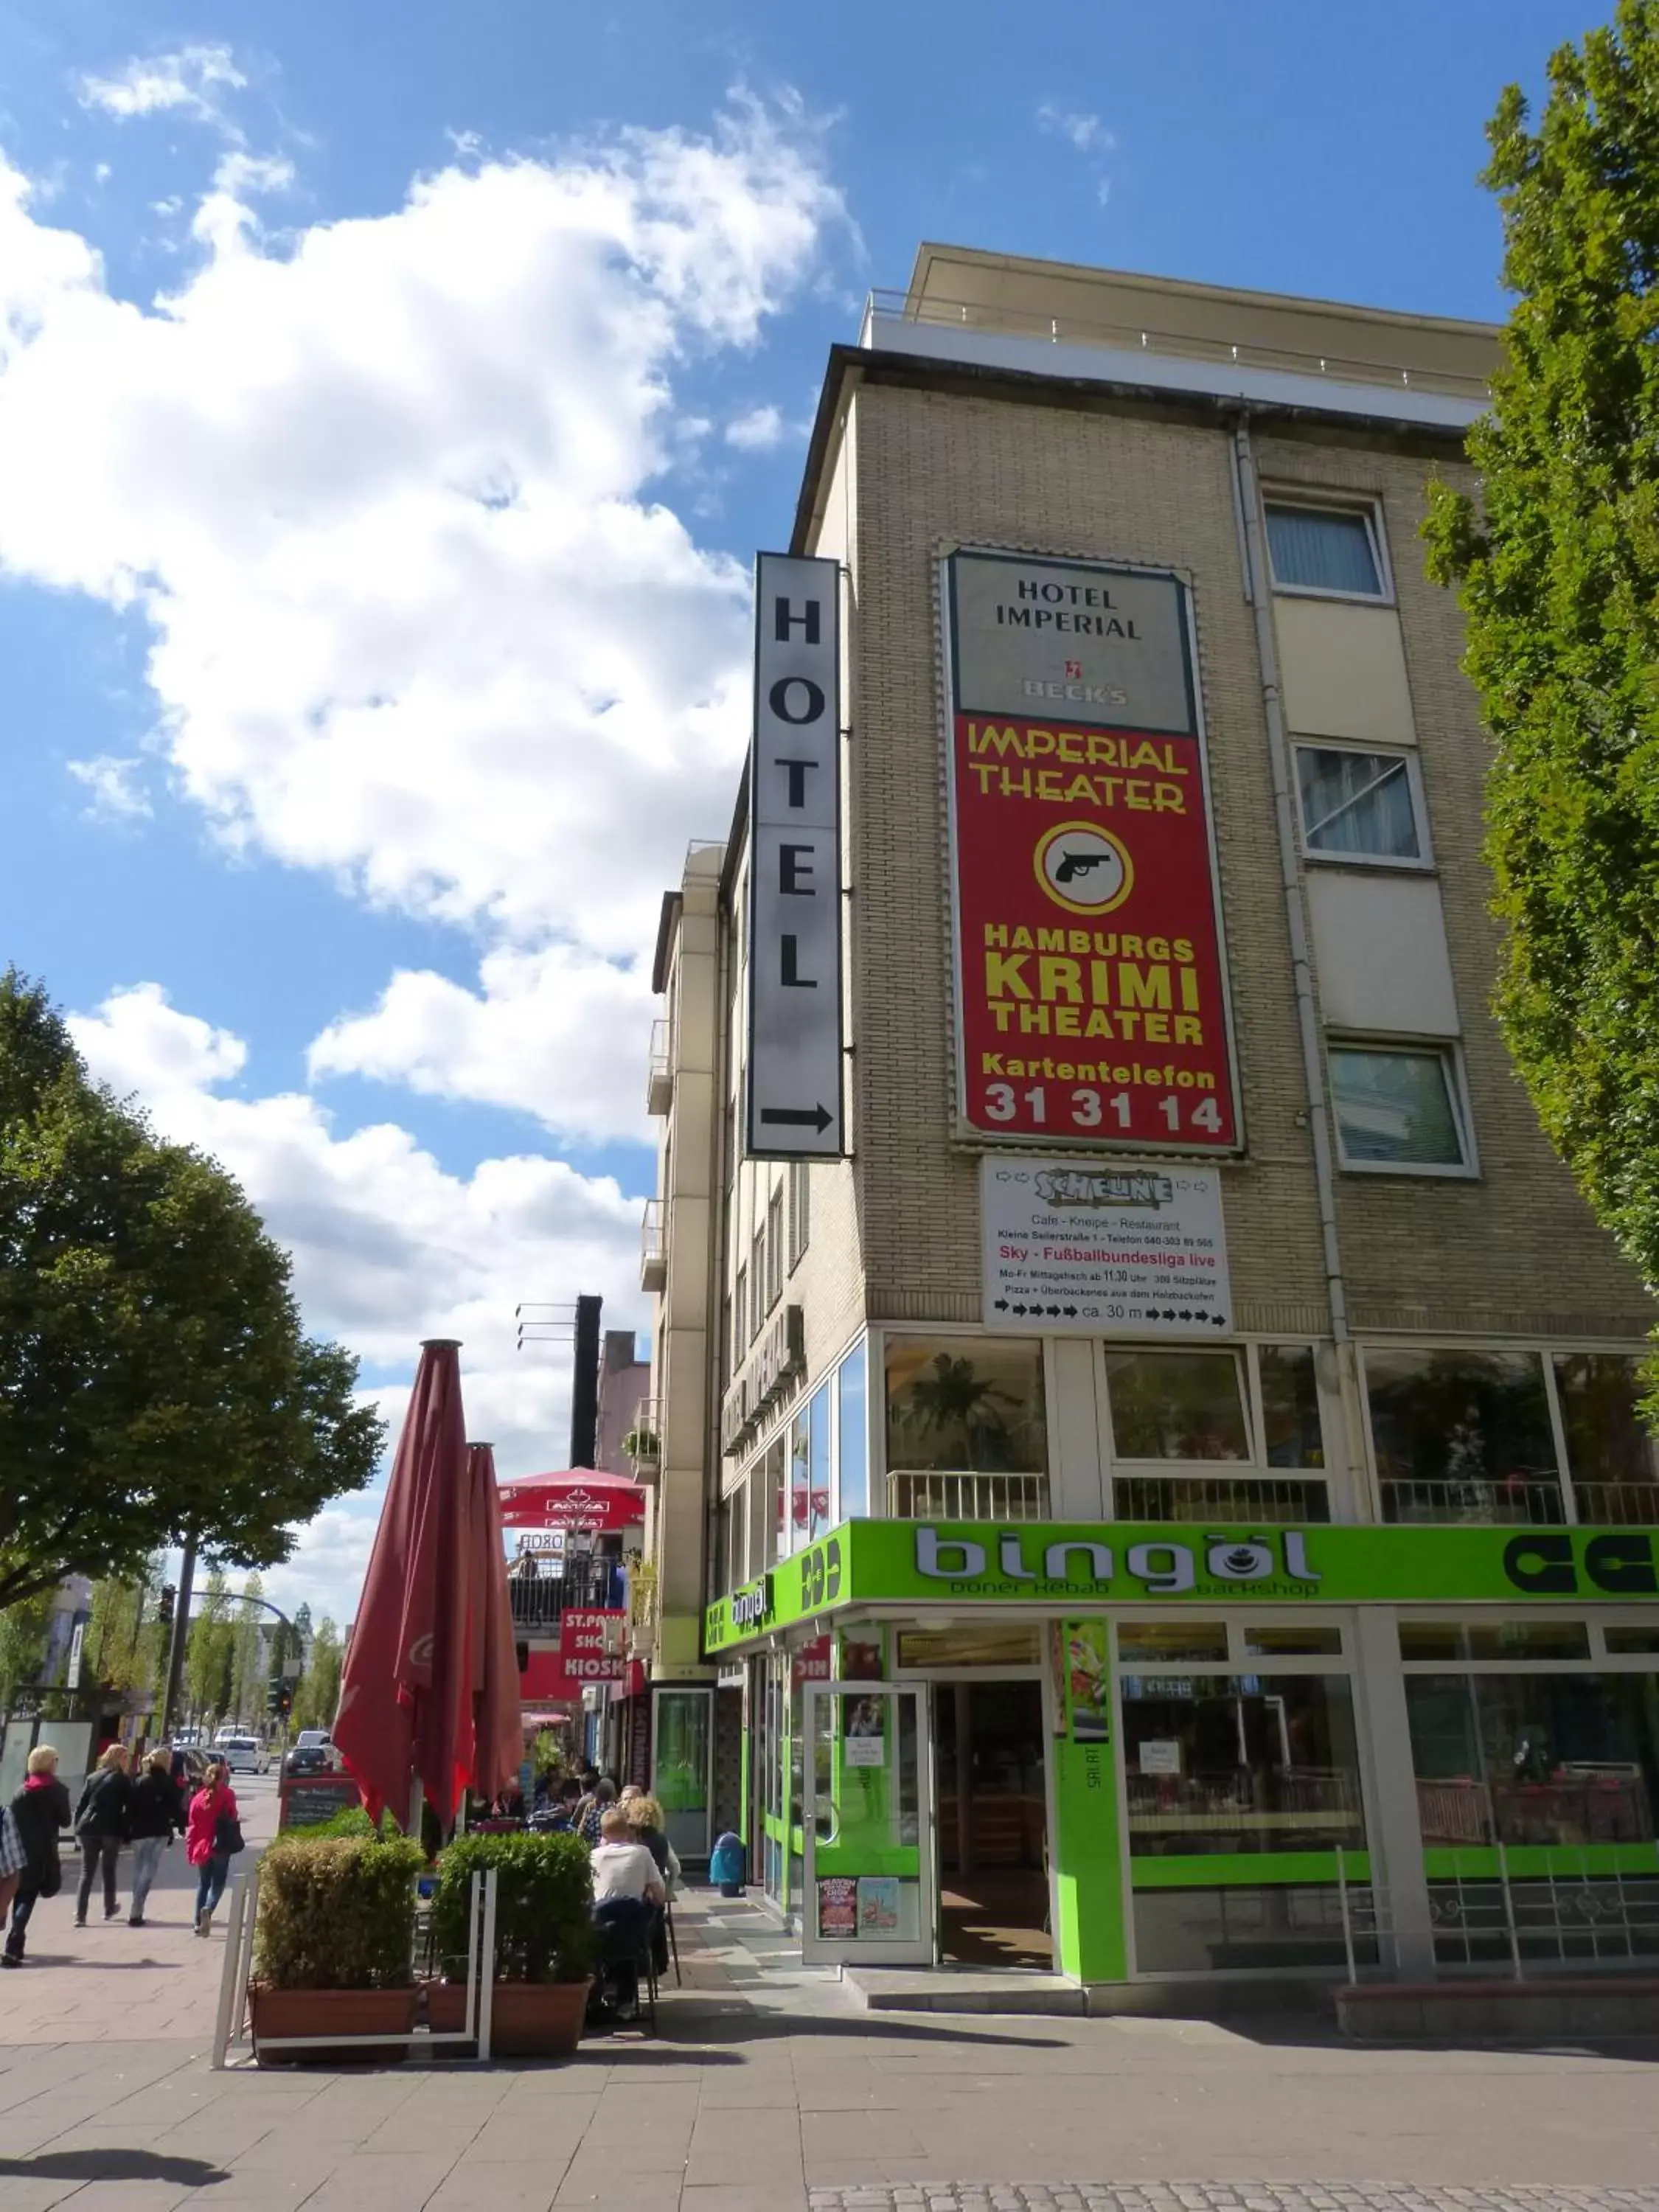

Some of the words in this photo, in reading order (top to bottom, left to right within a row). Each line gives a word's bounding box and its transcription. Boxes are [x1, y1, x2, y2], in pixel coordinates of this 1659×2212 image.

[1018, 580, 1119, 610] HOTEL
[995, 605, 1141, 641] IMPERIAL
[1023, 679, 1128, 705] BECK'S
[968, 723, 1189, 776] IMPERIAL
[769, 597, 825, 988] HOTEL
[968, 763, 1186, 815] THEATER
[984, 923, 1194, 963] HAMBURGS
[986, 952, 1199, 1013] KRIMI
[987, 1001, 1203, 1046] THEATER
[981, 1052, 1215, 1090] Kartentelefon
[984, 1083, 1046, 1123] 31
[1071, 1088, 1133, 1128] 31
[1159, 1095, 1222, 1133] 14
[998, 1230, 1029, 1239] Kleine
[1107, 1234, 1141, 1244] Telefon
[1070, 1217, 1109, 1230] Kneipe
[1120, 1219, 1180, 1231] Restaurant
[1000, 1245, 1028, 1262] Sky
[1043, 1247, 1185, 1267] Fußballbundesliga
[1189, 1252, 1215, 1267] live
[1005, 1285, 1030, 1294] Pizza
[1130, 1290, 1149, 1298] dem
[1107, 1304, 1124, 1318] 30
[1129, 1309, 1142, 1319] m
[914, 1526, 1322, 1592] bingöl
[566, 1659, 626, 1676] KIOSK
